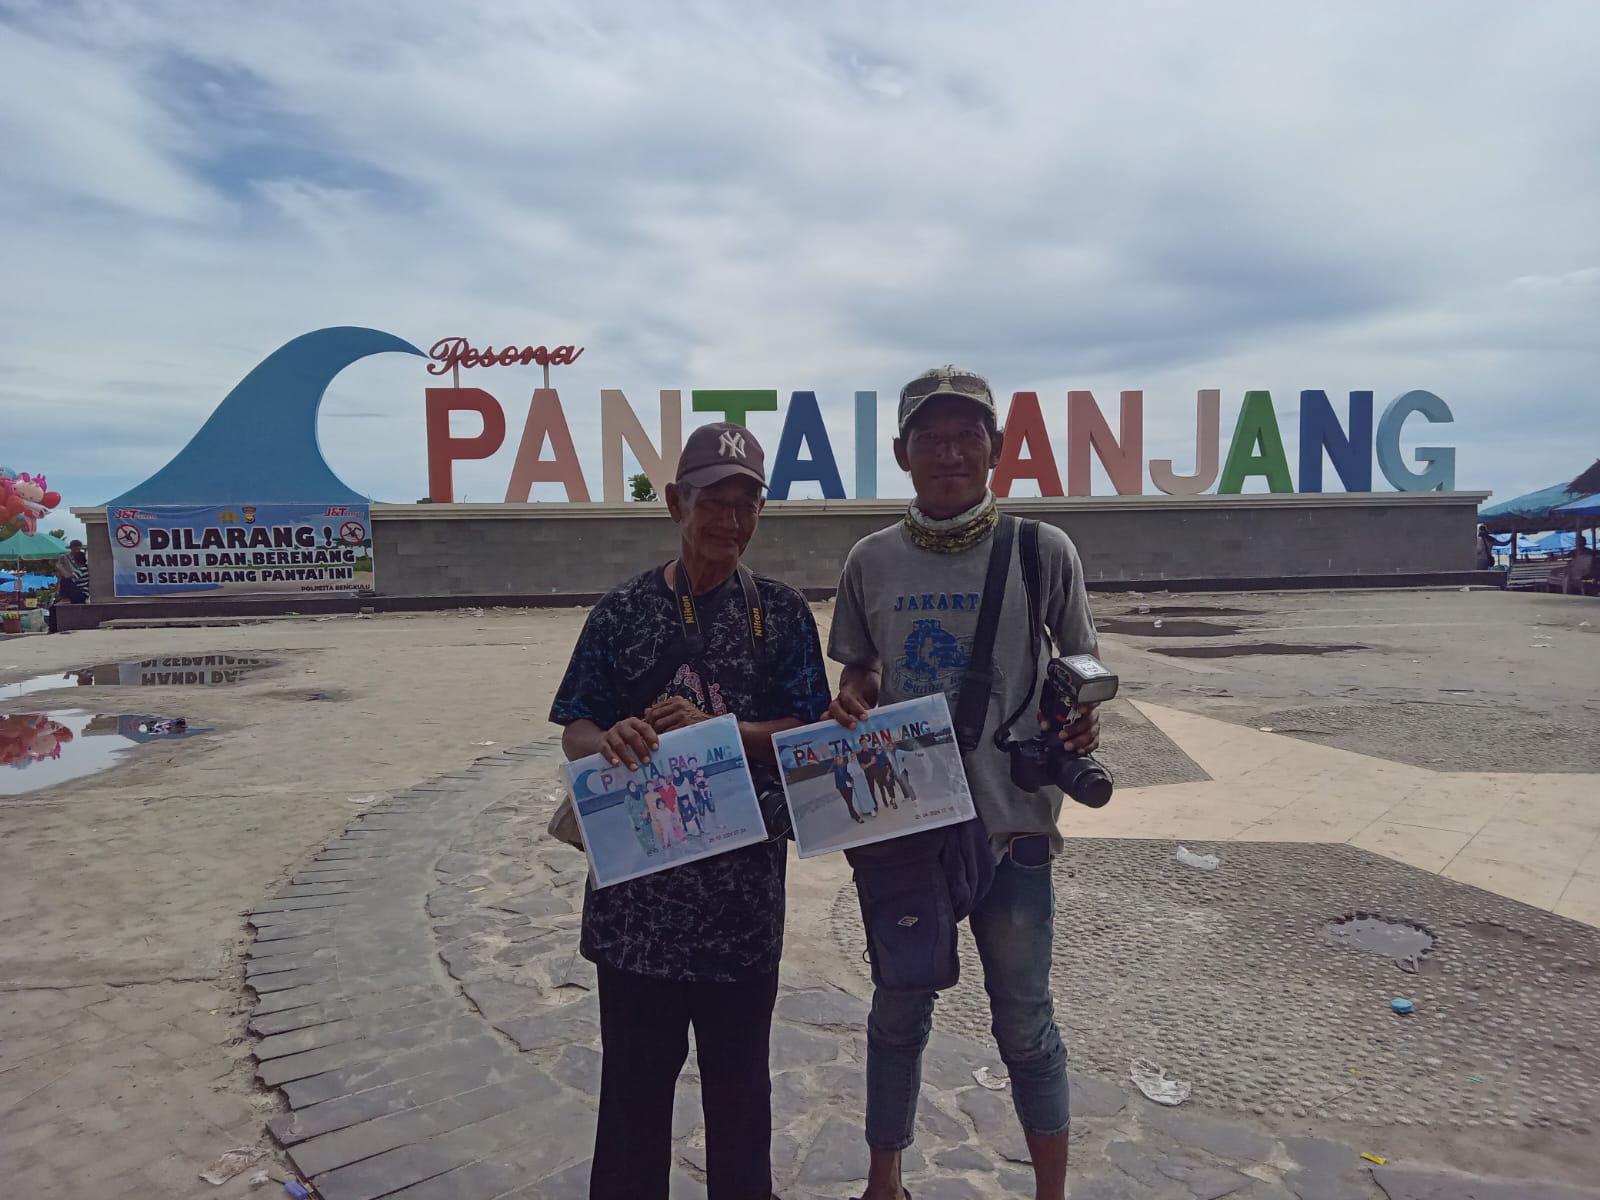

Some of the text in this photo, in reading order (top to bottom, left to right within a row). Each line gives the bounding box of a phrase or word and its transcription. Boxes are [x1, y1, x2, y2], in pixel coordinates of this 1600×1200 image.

[426, 336, 584, 376] Pesona
[991, 388, 1456, 498] ANJANG
[149, 526, 315, 551] DILARANG
[135, 549, 355, 568] MANDI DAN BERENANG
[136, 567, 353, 584] DI SEPANJANG PANTAI INI
[682, 595, 696, 625] Nikon
[893, 592, 980, 612] JAKART
[752, 607, 764, 638] Nikon
